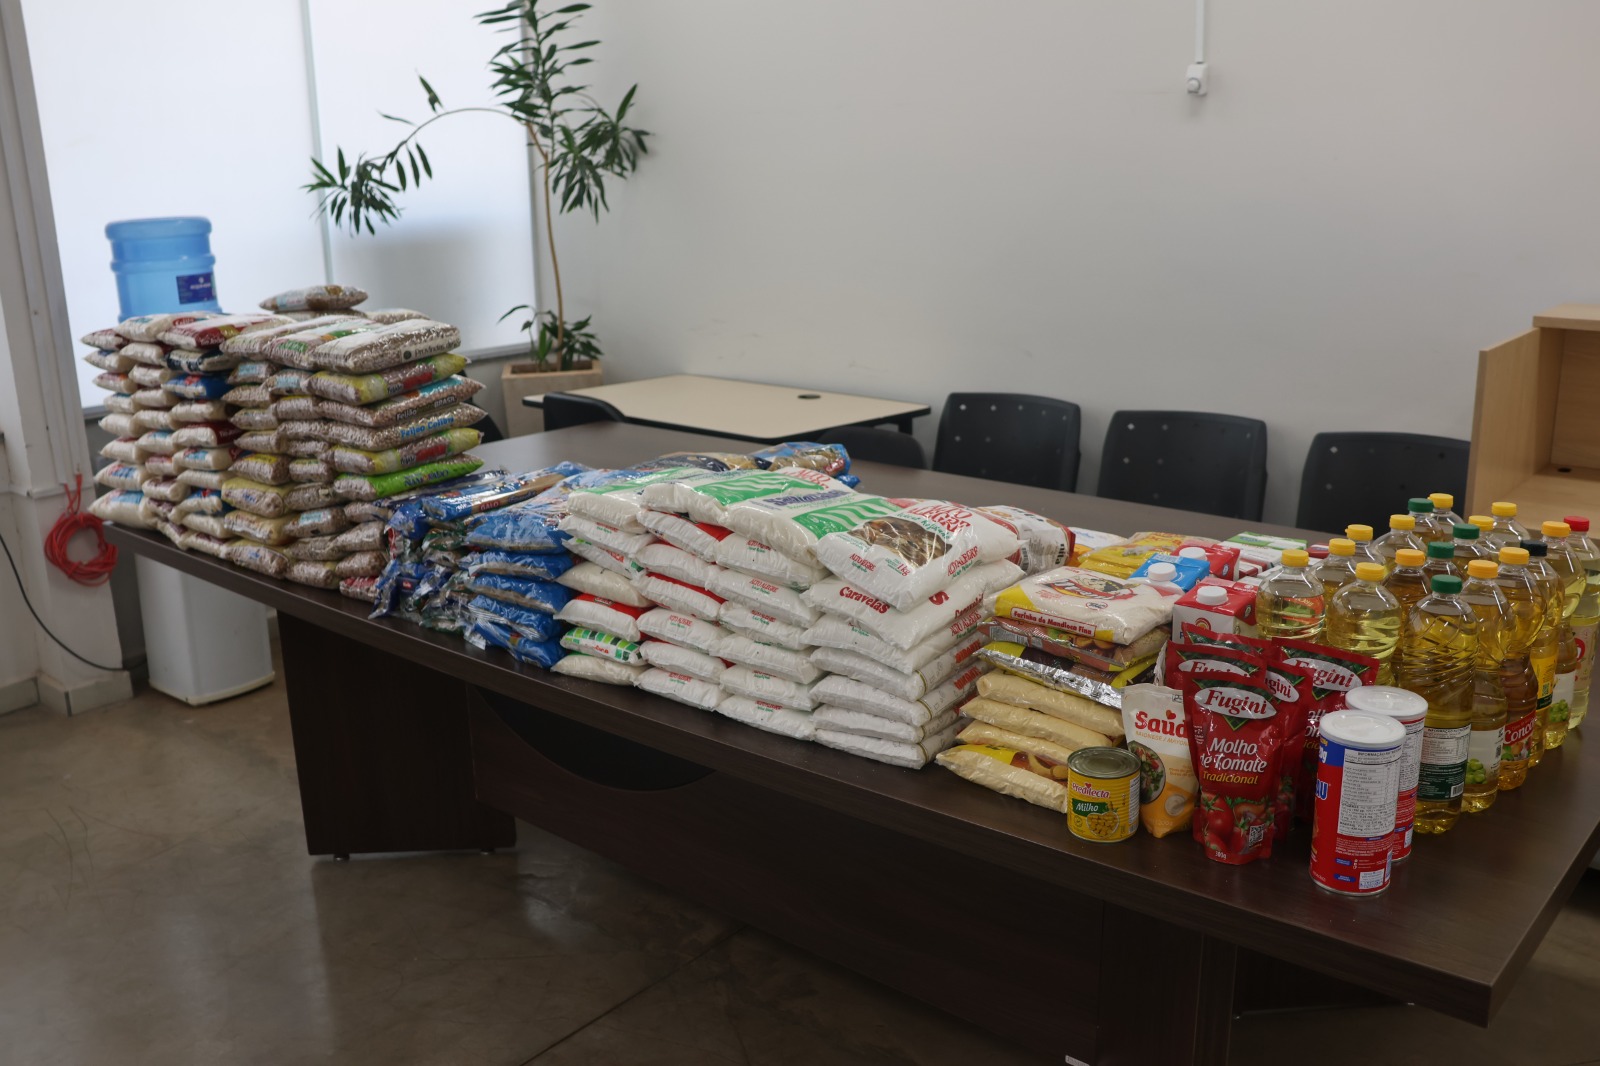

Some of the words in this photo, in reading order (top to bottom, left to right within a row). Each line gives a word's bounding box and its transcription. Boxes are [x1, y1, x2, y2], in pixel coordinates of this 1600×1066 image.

[839, 586, 891, 614] Caravelas
[1013, 610, 1037, 622] Farinha
[1038, 616, 1046, 624] de
[1047, 618, 1078, 631] Mandioca
[1078, 625, 1093, 636] Fina
[1203, 689, 1268, 715] Fugini
[1208, 737, 1258, 757] Molho
[1200, 753, 1212, 769] de
[1212, 753, 1268, 773] Tomate
[1202, 771, 1259, 785] Tradicional
[1075, 802, 1099, 812] Milho
